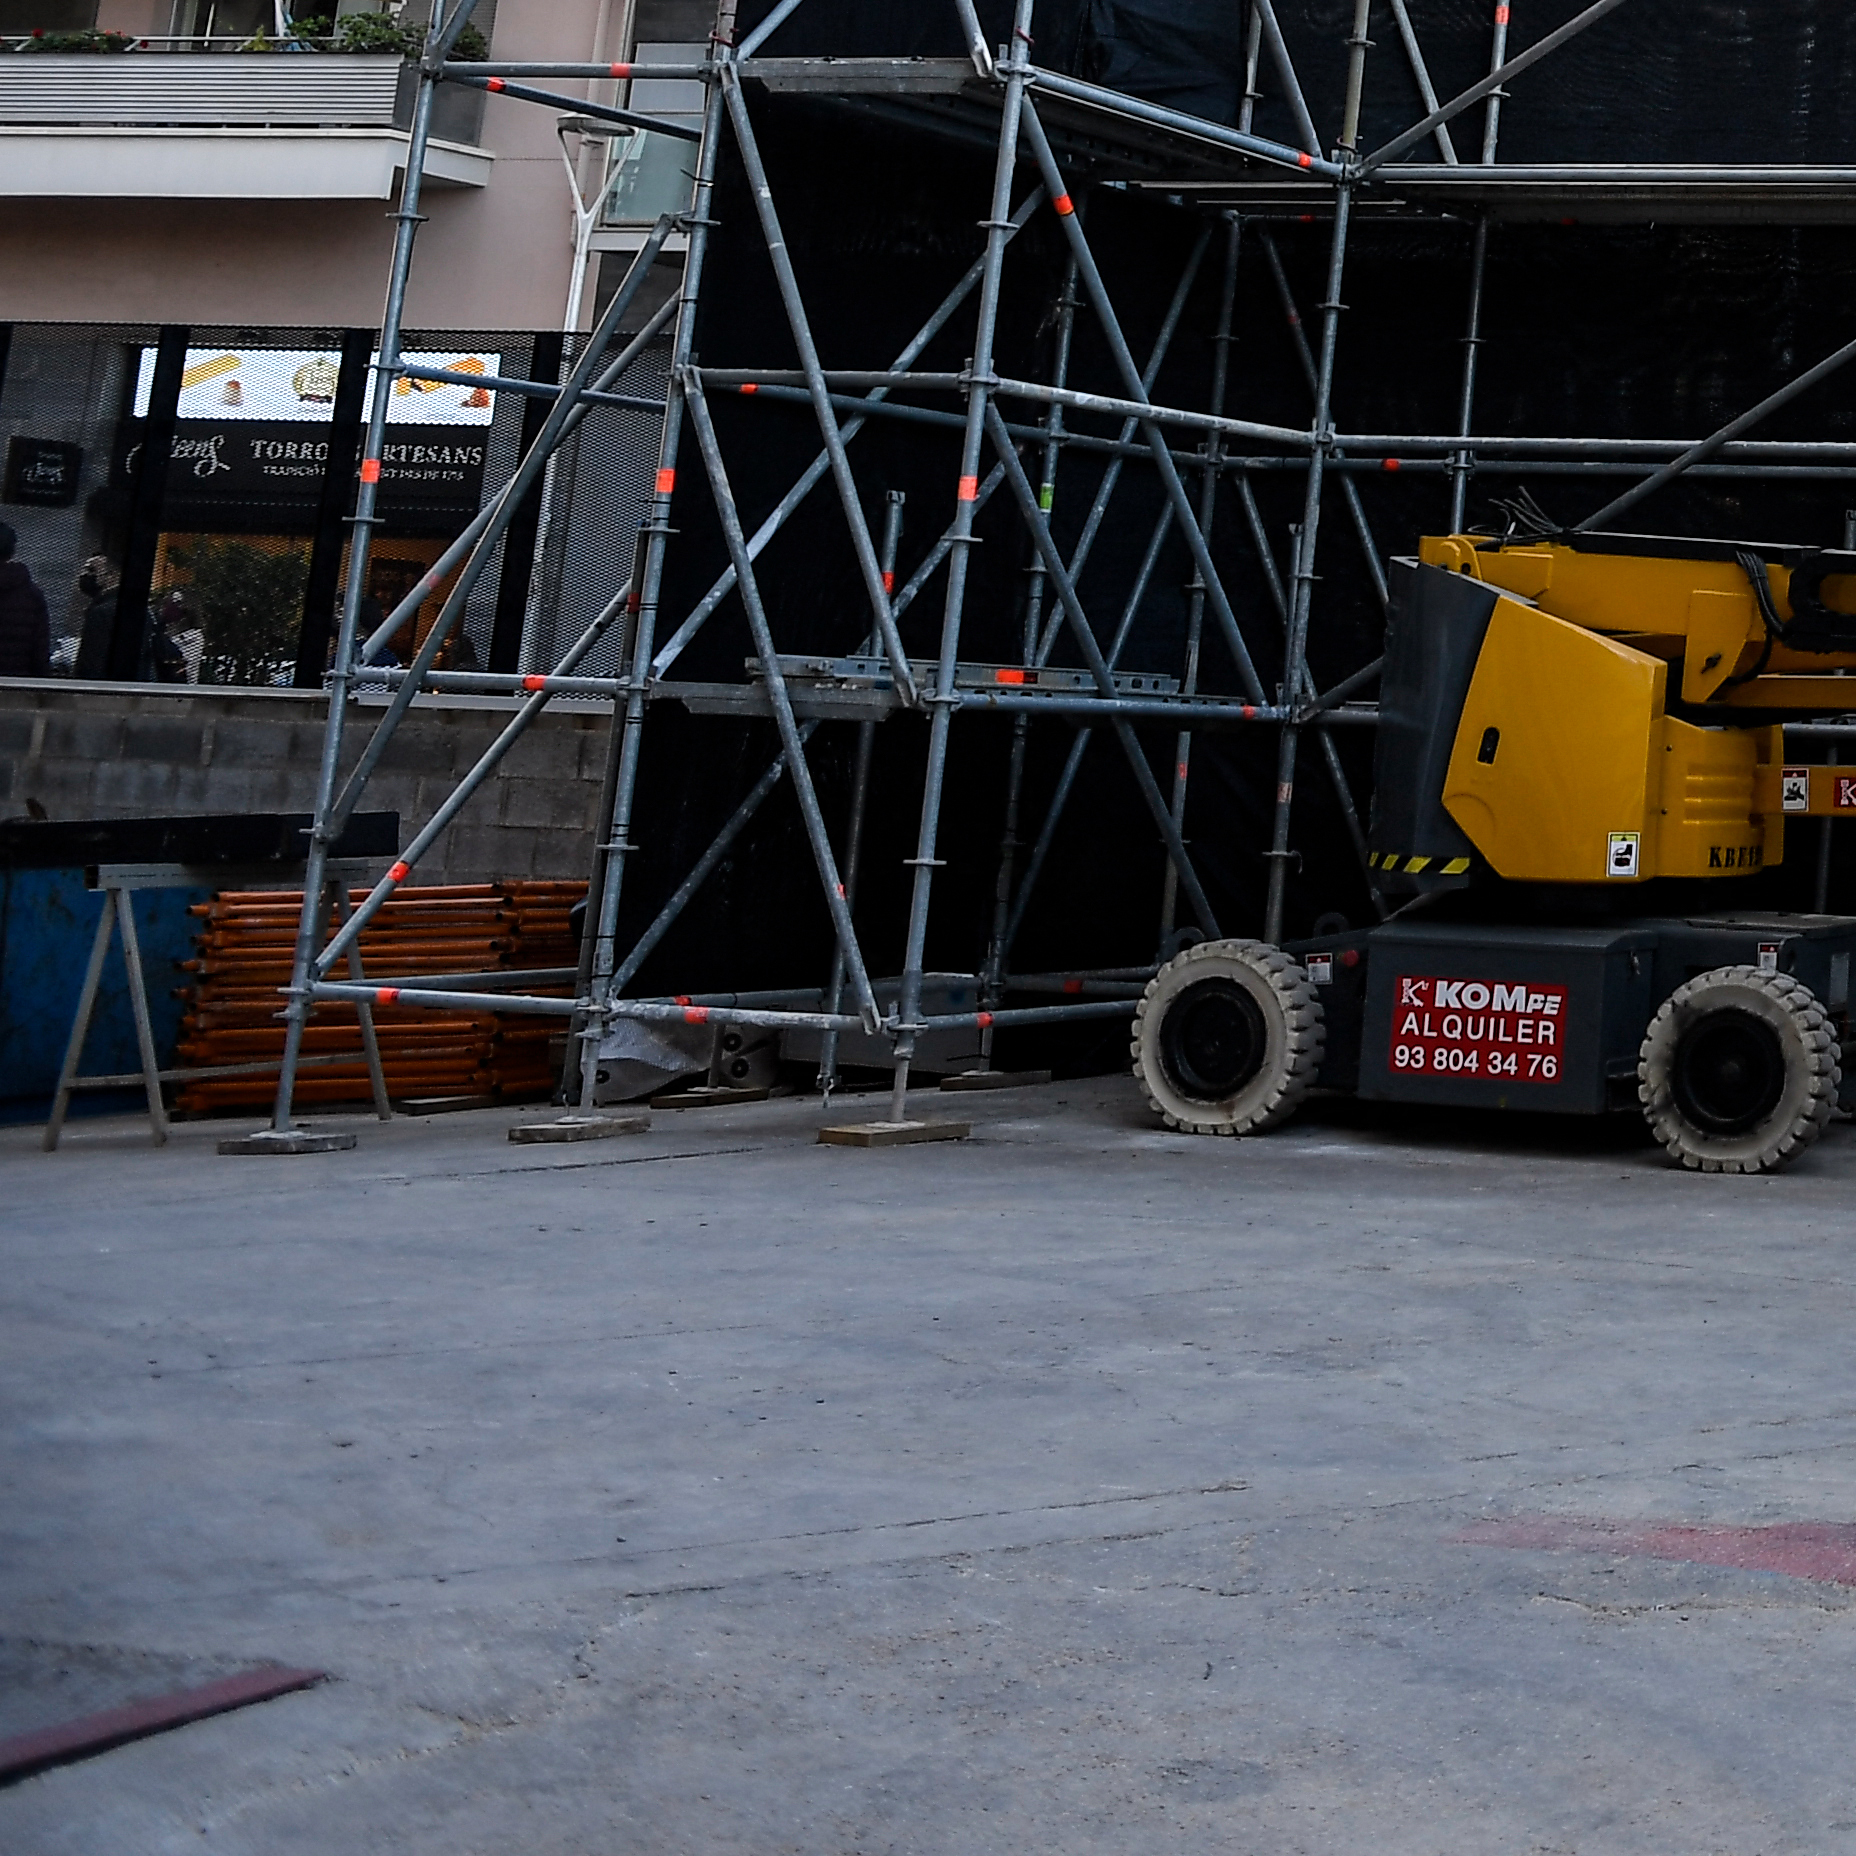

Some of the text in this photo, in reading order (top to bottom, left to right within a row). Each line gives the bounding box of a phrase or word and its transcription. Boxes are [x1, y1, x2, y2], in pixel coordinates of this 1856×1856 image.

[382, 443, 484, 466] RTESANS
[1400, 1011, 1555, 1045] ALQUILER
[1394, 1044, 1558, 1078] 93 804 34 76
